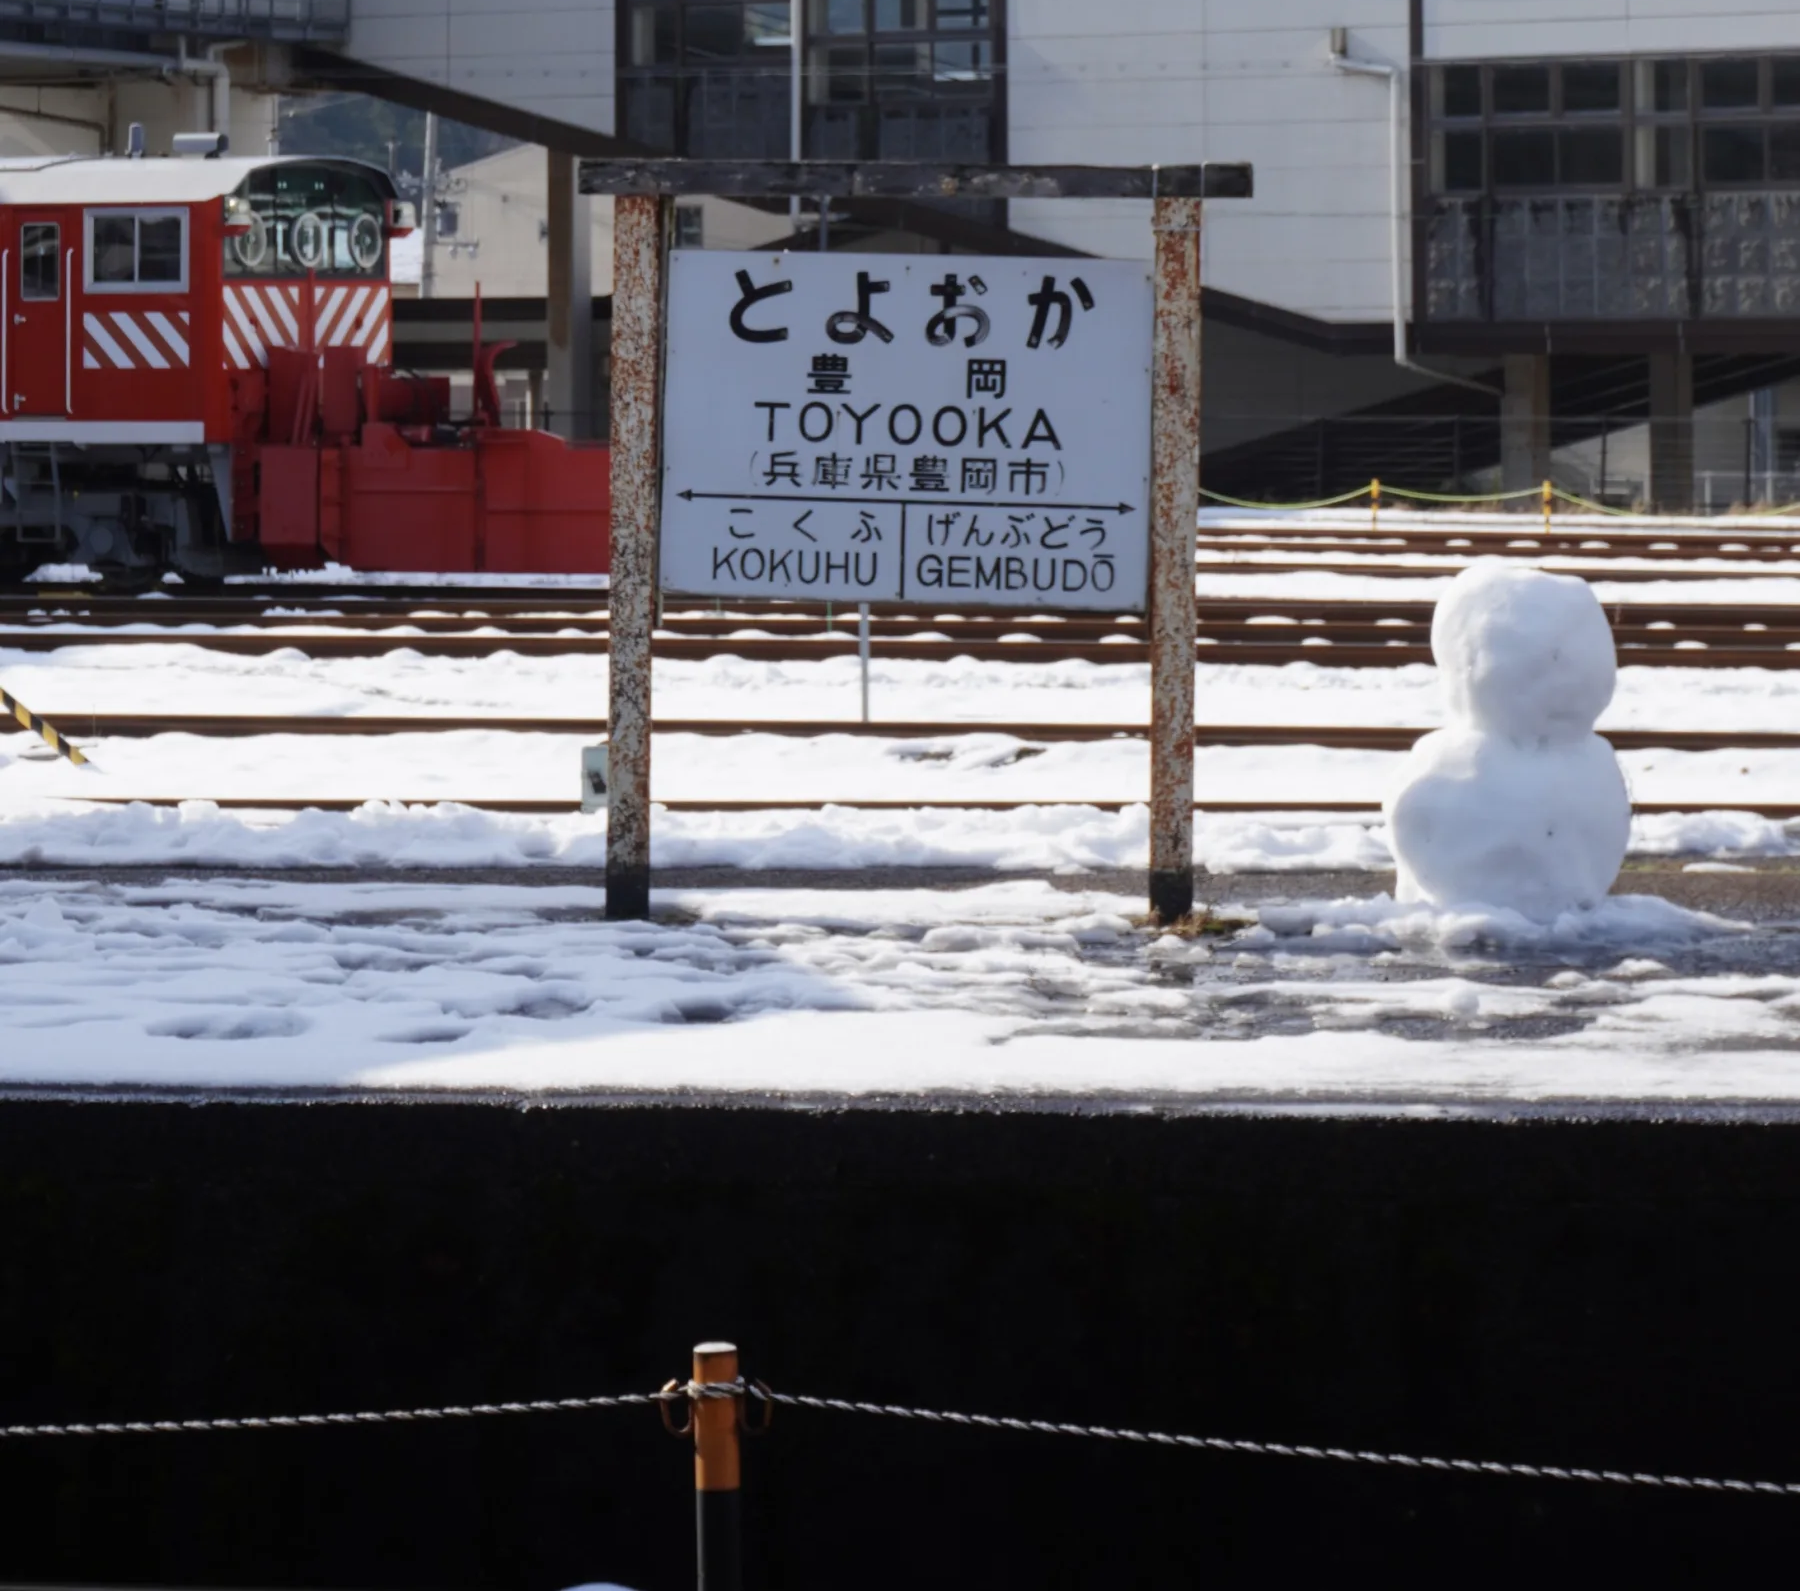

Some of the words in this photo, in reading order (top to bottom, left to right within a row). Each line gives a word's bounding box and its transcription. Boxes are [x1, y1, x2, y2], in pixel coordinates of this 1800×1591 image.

[728, 269, 1095, 350] とよおか
[755, 401, 1062, 450] TOYOOKA
[728, 508, 883, 543] こくふ
[927, 514, 1108, 550] げんぶどう
[712, 547, 878, 586] KOKUHU
[917, 554, 1116, 593] GEMBUDŌ
